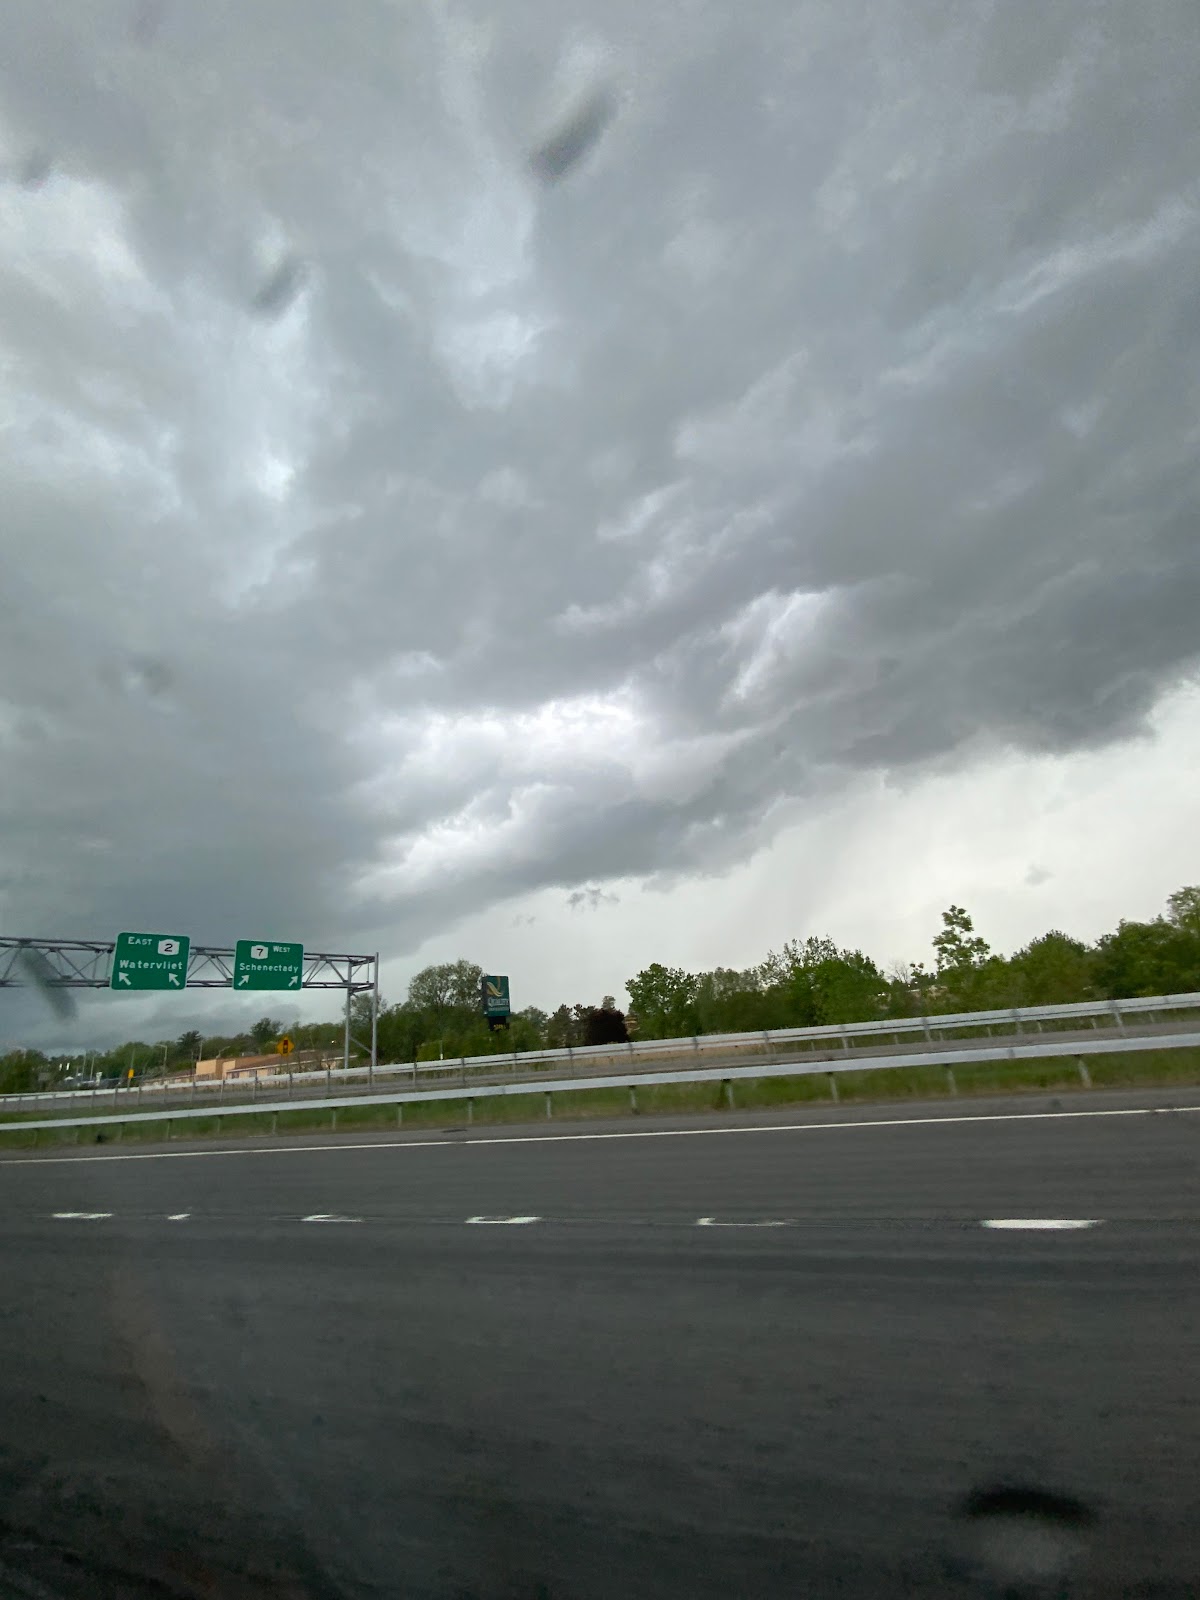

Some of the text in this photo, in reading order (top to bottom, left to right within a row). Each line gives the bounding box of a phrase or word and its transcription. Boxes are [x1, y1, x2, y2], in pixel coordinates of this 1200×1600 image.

[128, 936, 173, 952] EAST 2
[256, 945, 290, 956] 7 WEST
[119, 959, 183, 970] Watervliet
[239, 962, 299, 973] Schenectady
